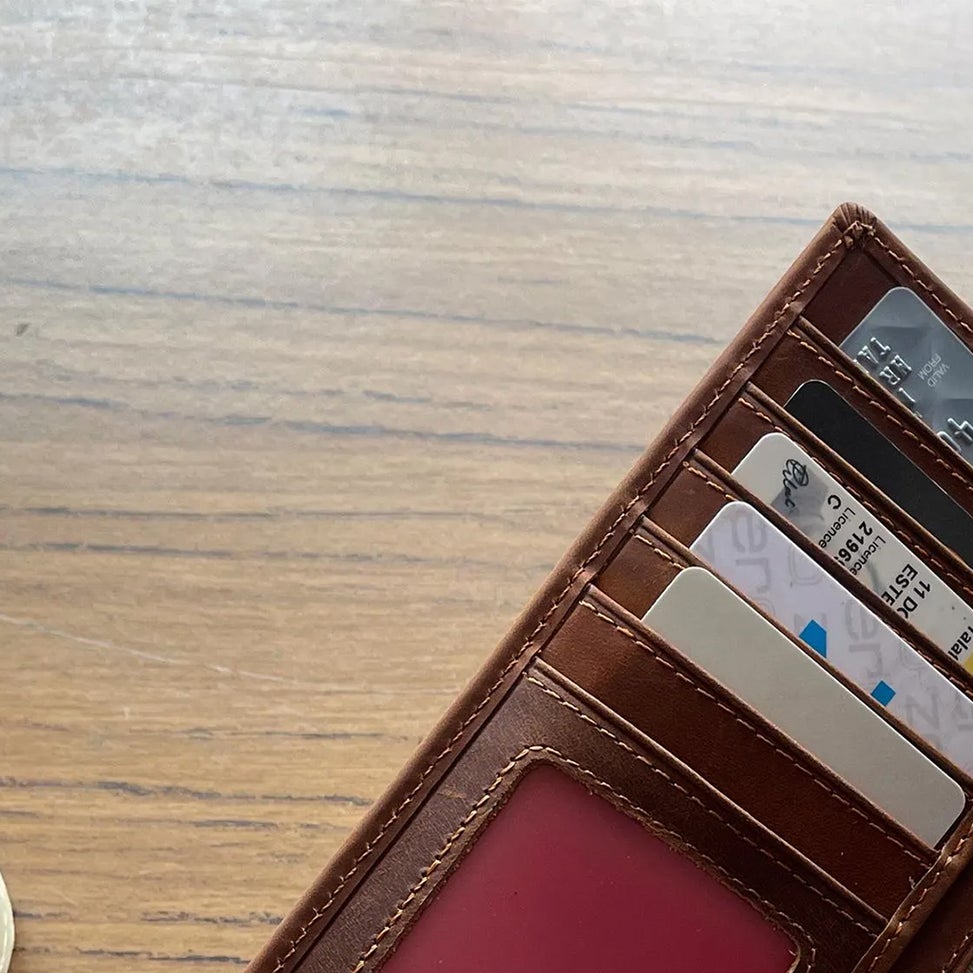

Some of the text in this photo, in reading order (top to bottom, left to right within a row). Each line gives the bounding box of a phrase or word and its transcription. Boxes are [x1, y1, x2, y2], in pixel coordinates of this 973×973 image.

[917, 352, 942, 380] FROM
[927, 363, 950, 388] VALID
[827, 494, 842, 510] C
[818, 507, 856, 549] Licence
[848, 535, 887, 576] Licence
[880, 563, 919, 606] ESTE
[913, 580, 931, 599] 11
